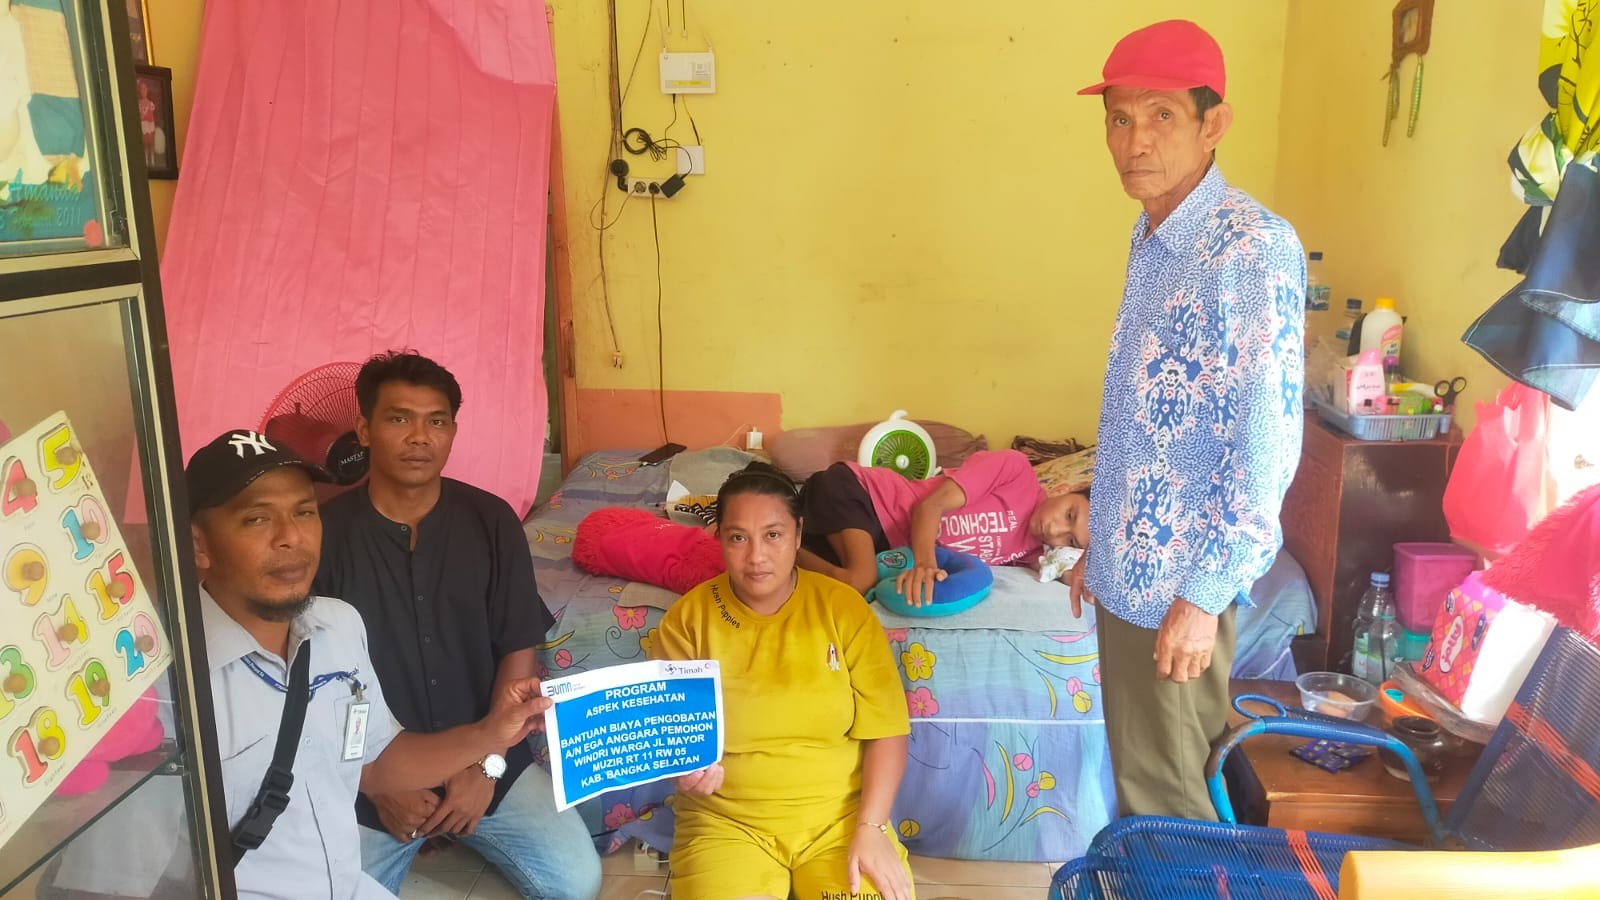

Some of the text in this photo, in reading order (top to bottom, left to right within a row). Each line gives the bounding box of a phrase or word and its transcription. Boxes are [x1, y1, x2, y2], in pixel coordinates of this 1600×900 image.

[710, 584, 741, 629] Hush Puppies
[678, 666, 703, 675] Timah
[586, 692, 686, 718] ASPEK KESEHATAN
[605, 681, 667, 701] PROGRAM
[561, 711, 716, 749] BANTUAN BIAYA PENGOBATAN
[565, 722, 714, 760] A/N EGA ANGGARA PEMOHON
[574, 734, 705, 768] WINDRI WARGA JL MAYOR
[592, 747, 687, 773] MUZIR RT 11 RW 05
[581, 754, 700, 788] KAB. BANGKA SELATAN
